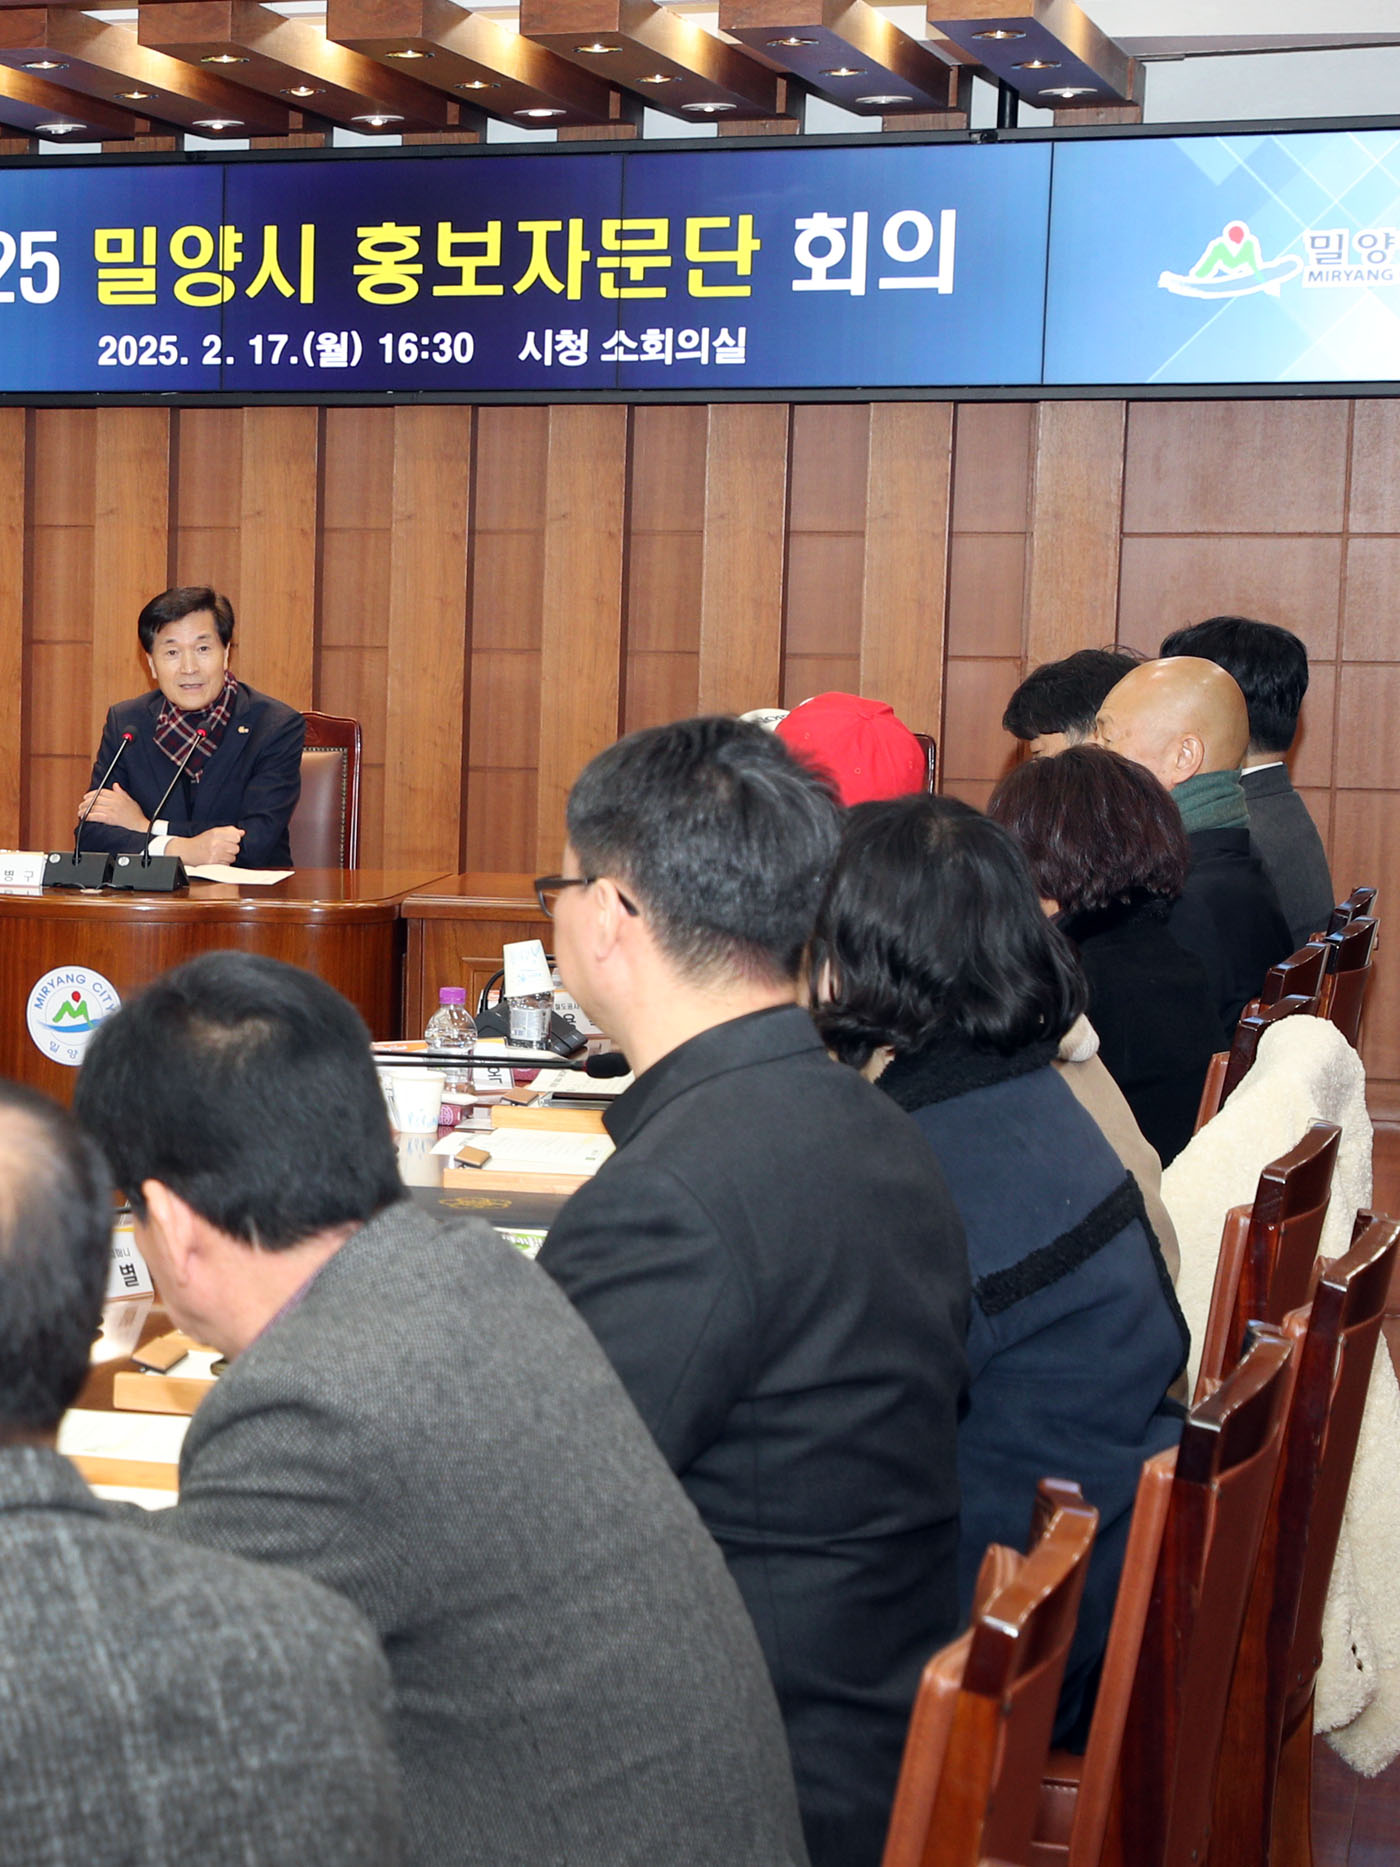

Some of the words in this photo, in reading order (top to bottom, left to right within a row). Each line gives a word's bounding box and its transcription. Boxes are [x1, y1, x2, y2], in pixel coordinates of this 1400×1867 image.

[94, 224, 315, 307] 밀양시
[353, 213, 761, 306] 홍보자문단
[791, 207, 958, 296] 회의
[1309, 231, 1396, 264] 밀양
[1307, 268, 1393, 282] MIRYANG
[98, 334, 189, 366] 2025.
[202, 334, 234, 366] 2.
[378, 331, 474, 364] 16:30
[518, 328, 589, 367] 시청
[600, 326, 747, 367] 소회의실
[34, 973, 87, 1010] MIRYANG
[92, 982, 117, 1012] CITY
